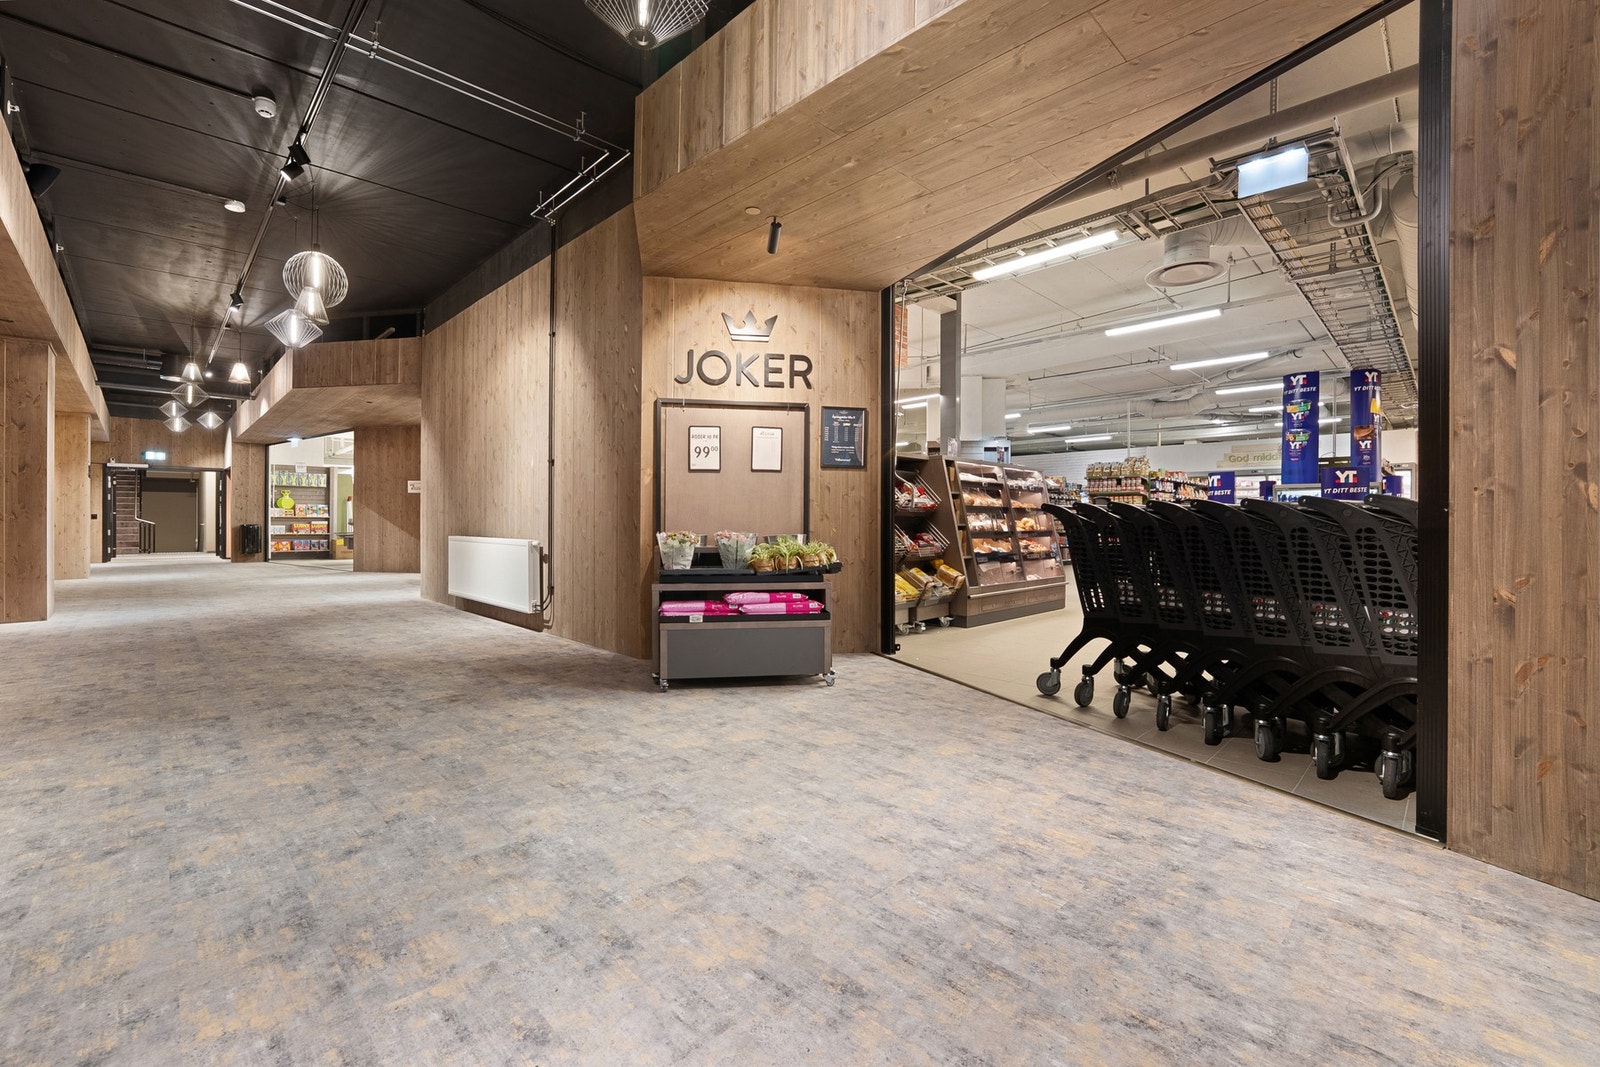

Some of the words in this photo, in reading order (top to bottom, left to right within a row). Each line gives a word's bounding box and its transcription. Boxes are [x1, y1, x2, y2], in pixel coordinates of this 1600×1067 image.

[674, 349, 812, 390] JOKER
[1290, 374, 1307, 386] YT
[1364, 371, 1379, 383] YT
[1291, 411, 1305, 420] YT
[1289, 441, 1302, 450] YT
[1359, 440, 1372, 449] YT
[1228, 454, 1249, 463] God
[1208, 474, 1221, 487] YT
[1335, 470, 1357, 484] YT
